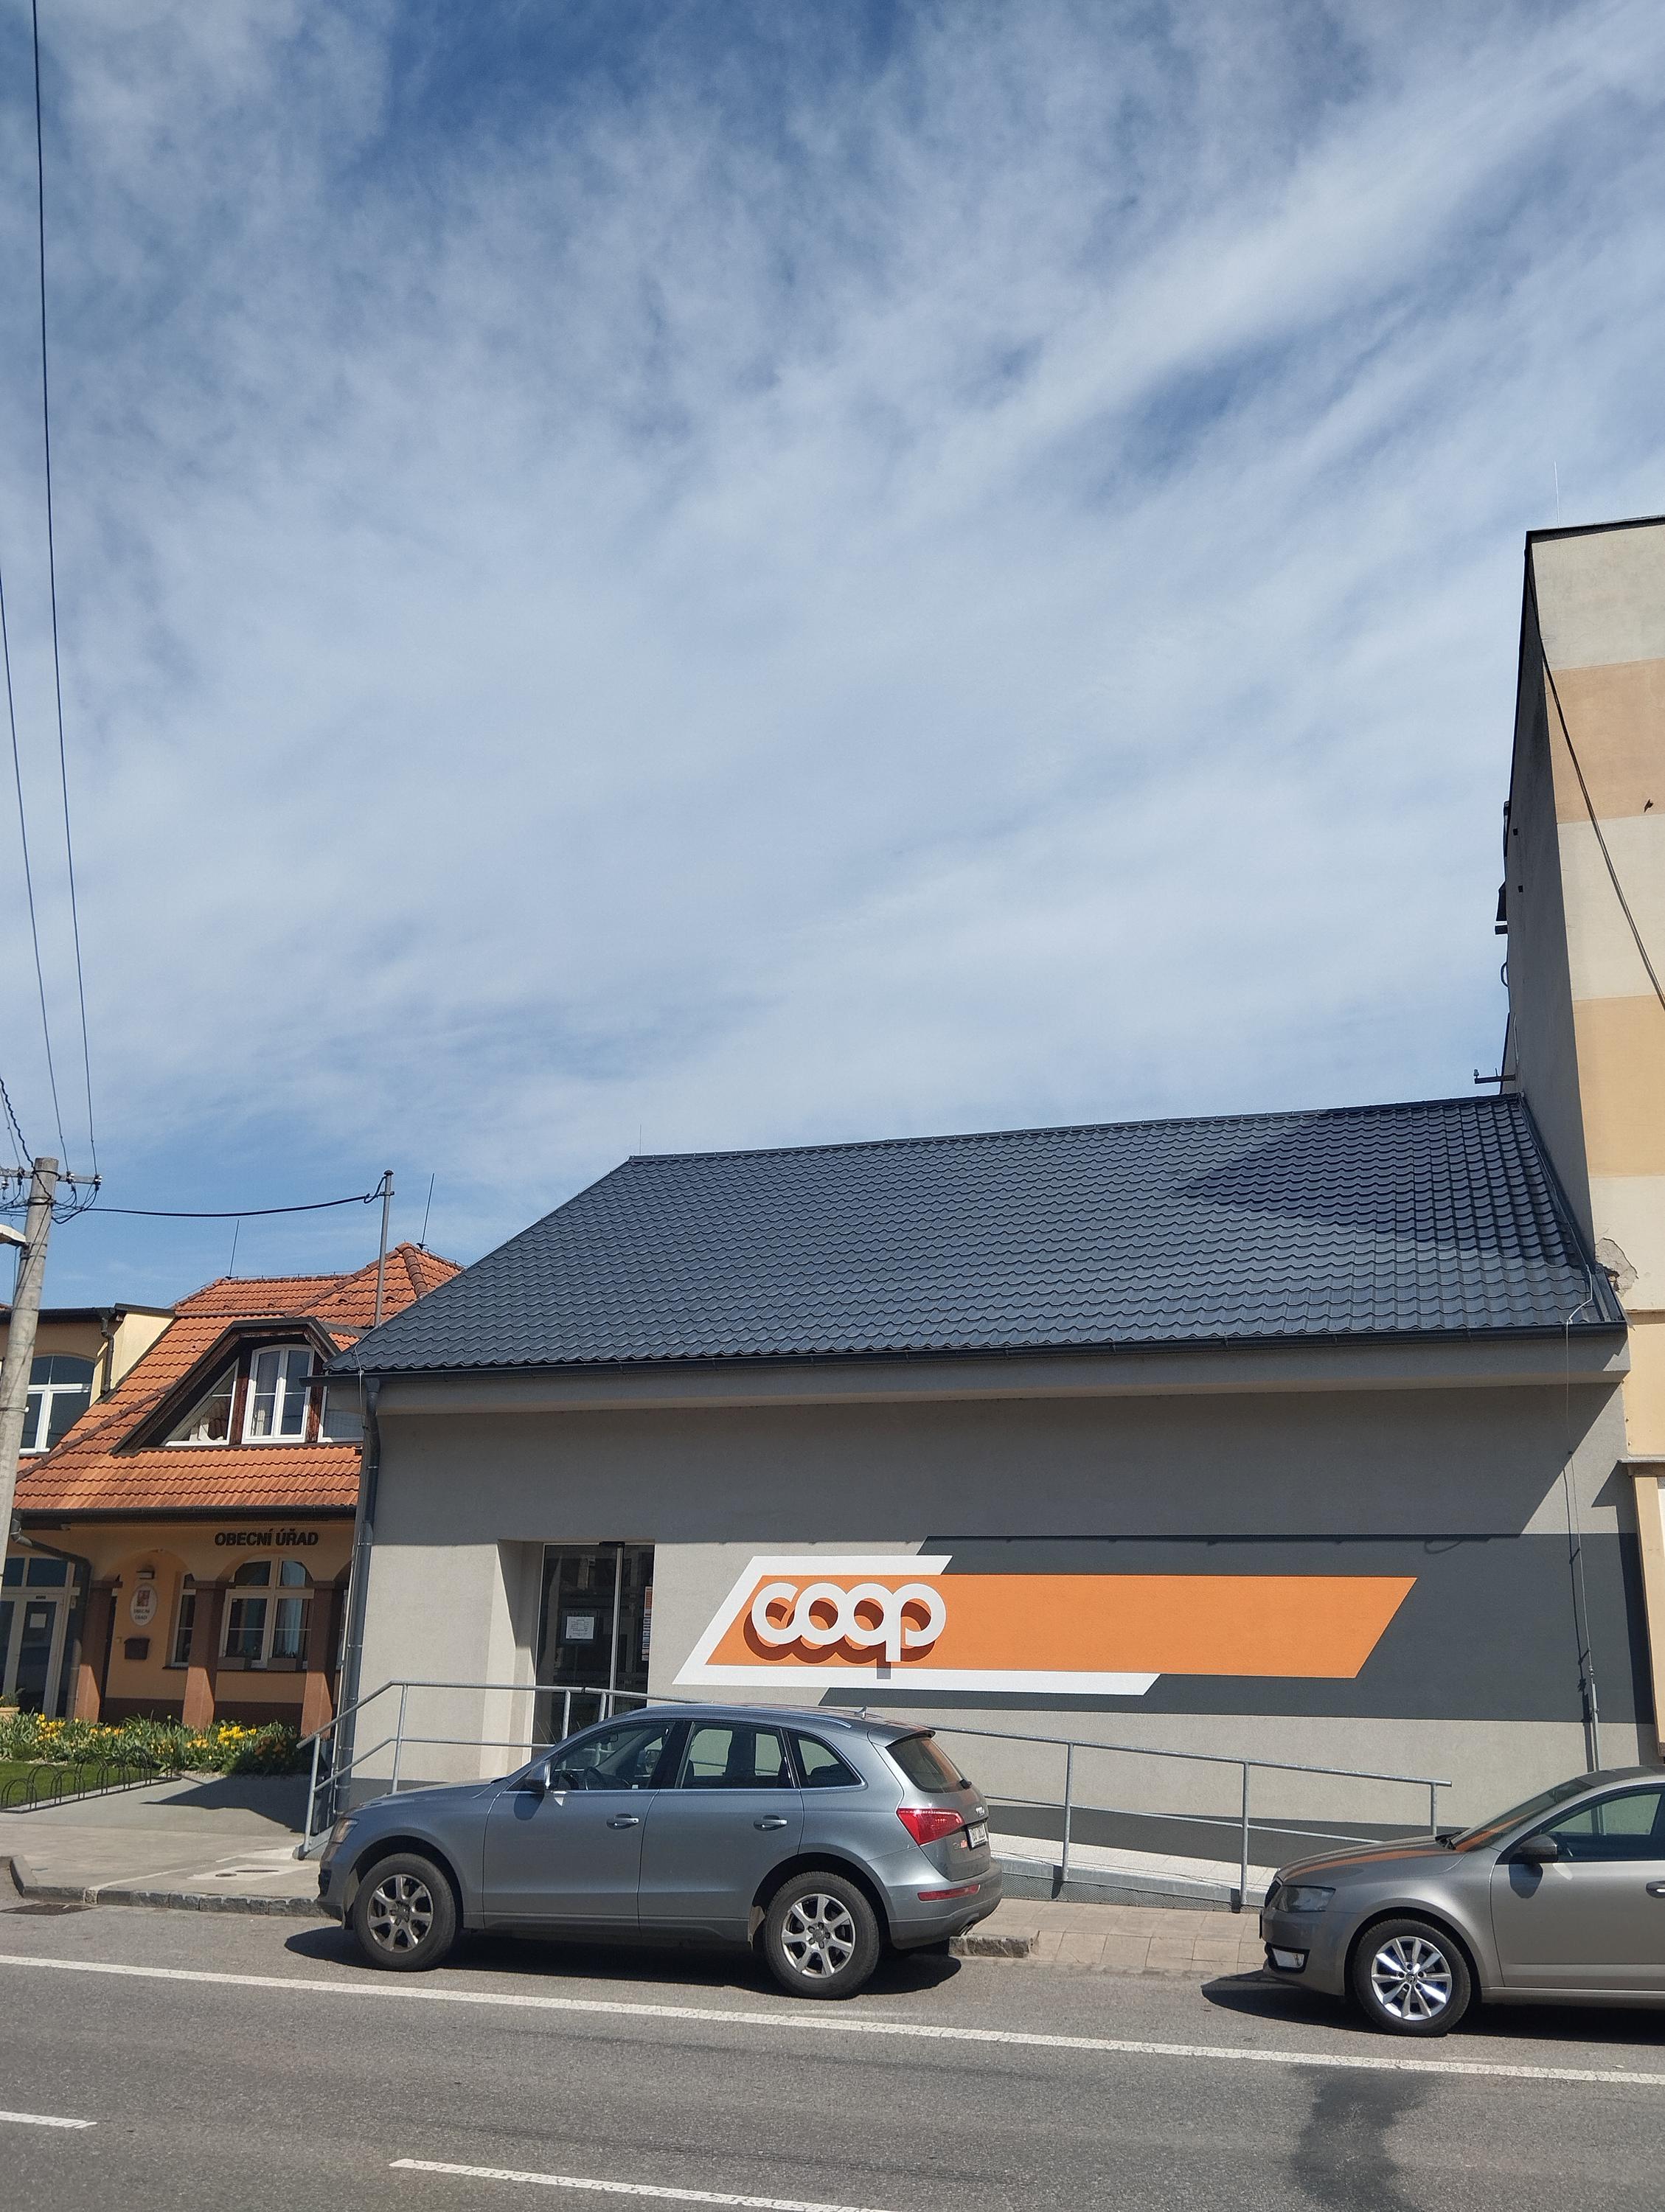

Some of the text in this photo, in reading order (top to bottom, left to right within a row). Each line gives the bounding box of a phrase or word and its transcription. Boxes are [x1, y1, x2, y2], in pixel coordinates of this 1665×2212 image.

[215, 1528, 319, 1546] OBECNÍ ÚŘAD
[751, 1582, 946, 1662] coop
